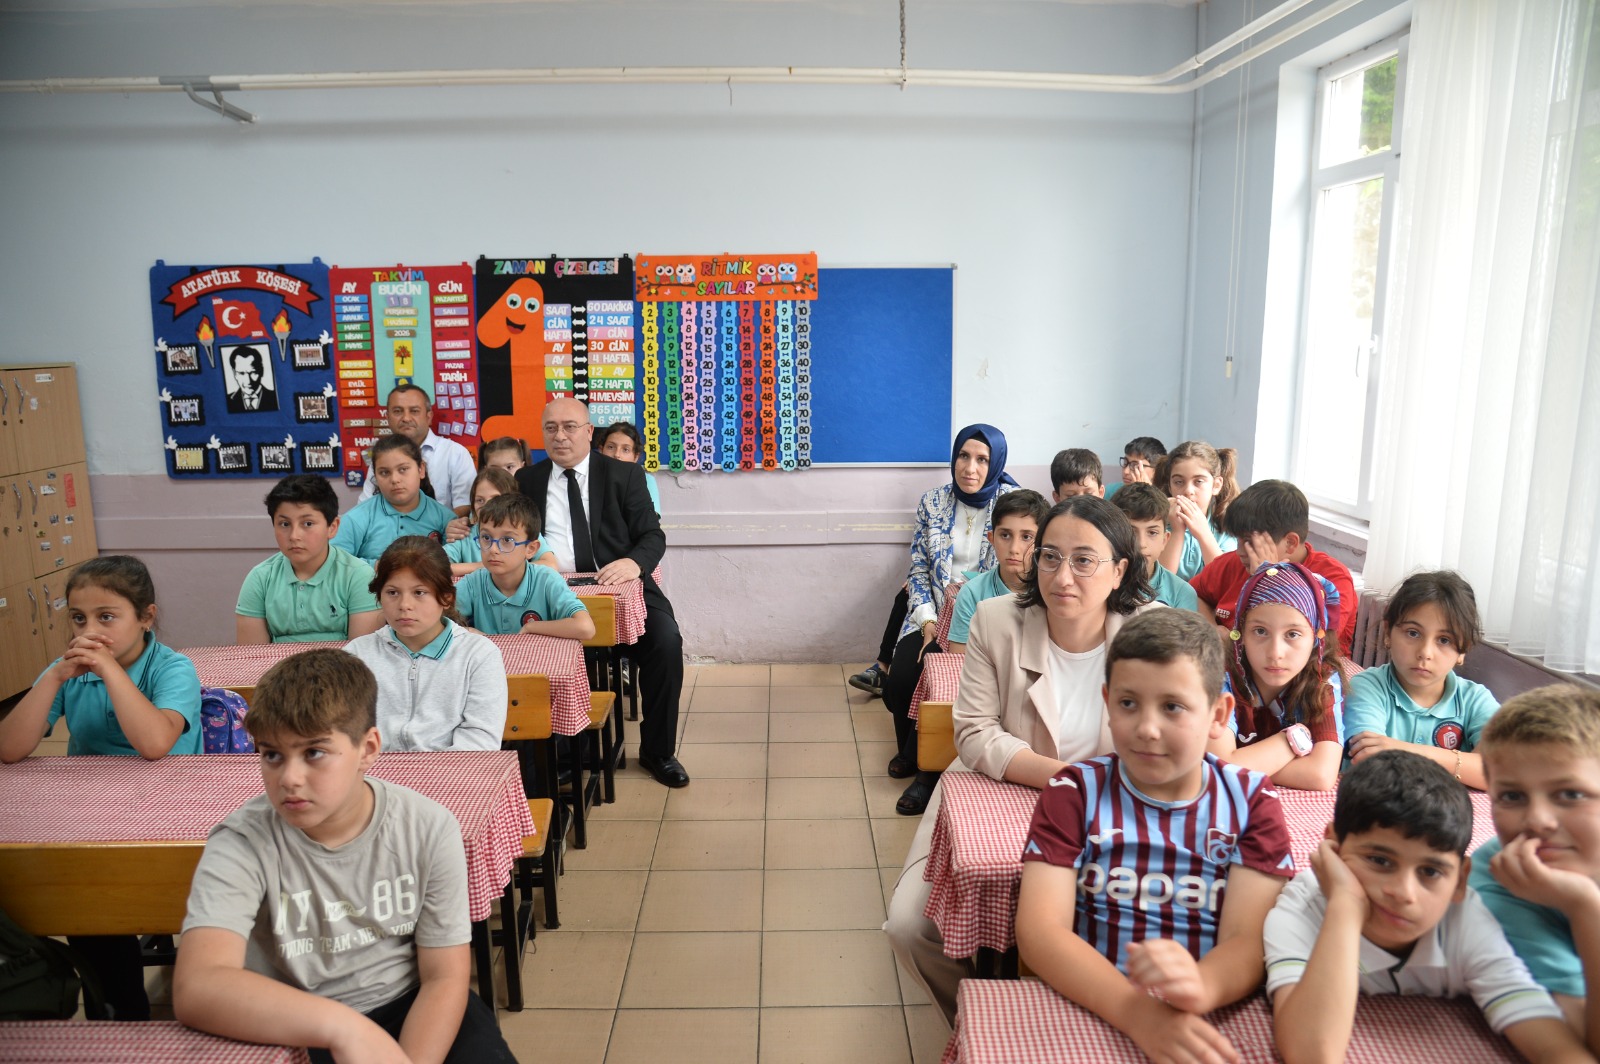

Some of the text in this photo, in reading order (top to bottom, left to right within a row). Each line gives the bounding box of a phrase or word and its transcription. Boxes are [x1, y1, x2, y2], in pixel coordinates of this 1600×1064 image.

[494, 258, 619, 278] ZAMAN ÇİZELGESİ
[701, 258, 752, 276] RİTMİK
[373, 268, 424, 282] TAKVİM
[180, 270, 302, 298] ATATÜRK KÖŞESİ
[342, 282, 357, 293] AY
[438, 281, 462, 292] GÜN
[378, 282, 422, 295] BUGÜN
[696, 281, 756, 296] SAYILAR
[546, 306, 568, 315] SAAT
[587, 301, 633, 312] 60 DAKİKA
[648, 309, 652, 317] 2
[667, 308, 673, 317] 3
[706, 310, 711, 318] 5
[726, 309, 732, 317] 6
[743, 308, 749, 317] 7
[764, 308, 770, 317] 8
[782, 307, 787, 315] 9
[798, 307, 808, 315] 10
[547, 318, 567, 328] GÜN
[589, 316, 630, 325] 24 SAAT
[667, 325, 674, 333] 6
[686, 325, 692, 333] 8
[705, 327, 712, 335] 10
[726, 327, 733, 335] 12
[782, 324, 789, 332] 18
[797, 324, 808, 333] 20
[544, 331, 572, 340] HAFTA
[593, 327, 627, 338] 7 GÜN
[552, 343, 566, 352] AY
[590, 339, 629, 351] 30 GÜN
[648, 343, 653, 351] 6
[668, 342, 674, 351] 9
[685, 342, 692, 350] 12
[704, 344, 712, 353] 15
[781, 342, 790, 350] 27
[798, 341, 809, 350] 30
[552, 355, 565, 364] AY
[592, 354, 630, 363] 4 HAFTA
[797, 358, 809, 367] 40
[648, 359, 653, 368] 8
[703, 361, 713, 369] 20
[780, 359, 790, 367] 36
[552, 368, 567, 377] YIL
[591, 367, 626, 376] 12 AY
[440, 371, 468, 381] TARİH
[684, 375, 694, 383] 20
[798, 375, 808, 383] 50
[553, 380, 567, 389] YIL
[590, 380, 633, 388] 52 HAFTA
[703, 379, 713, 387] 25
[762, 377, 773, 385] 40
[590, 390, 634, 401] 4 MEVSİM
[725, 394, 734, 402] 36
[762, 393, 772, 401] 48
[798, 392, 809, 401] 60
[703, 396, 714, 404] 30
[590, 404, 631, 414] 365 GÜN
[798, 409, 809, 417] 70
[598, 416, 604, 424] 6
[702, 412, 712, 420] 35
[686, 426, 694, 434] 32
[702, 429, 713, 437] 40
[724, 428, 735, 436] 48
[798, 426, 810, 434] 80
[354, 438, 379, 446] HAV
[649, 444, 656, 452] 18
[742, 444, 753, 452] 63
[764, 443, 773, 451] 72
[784, 443, 791, 451] 81
[798, 443, 809, 451] 90
[671, 460, 682, 469] 30
[702, 462, 712, 470] 50
[742, 461, 752, 469] 70
[784, 460, 794, 468] 90
[796, 458, 810, 467] 100
[373, 874, 416, 922] 86
[320, 933, 351, 953] TEAM
[390, 919, 418, 936] YOR
